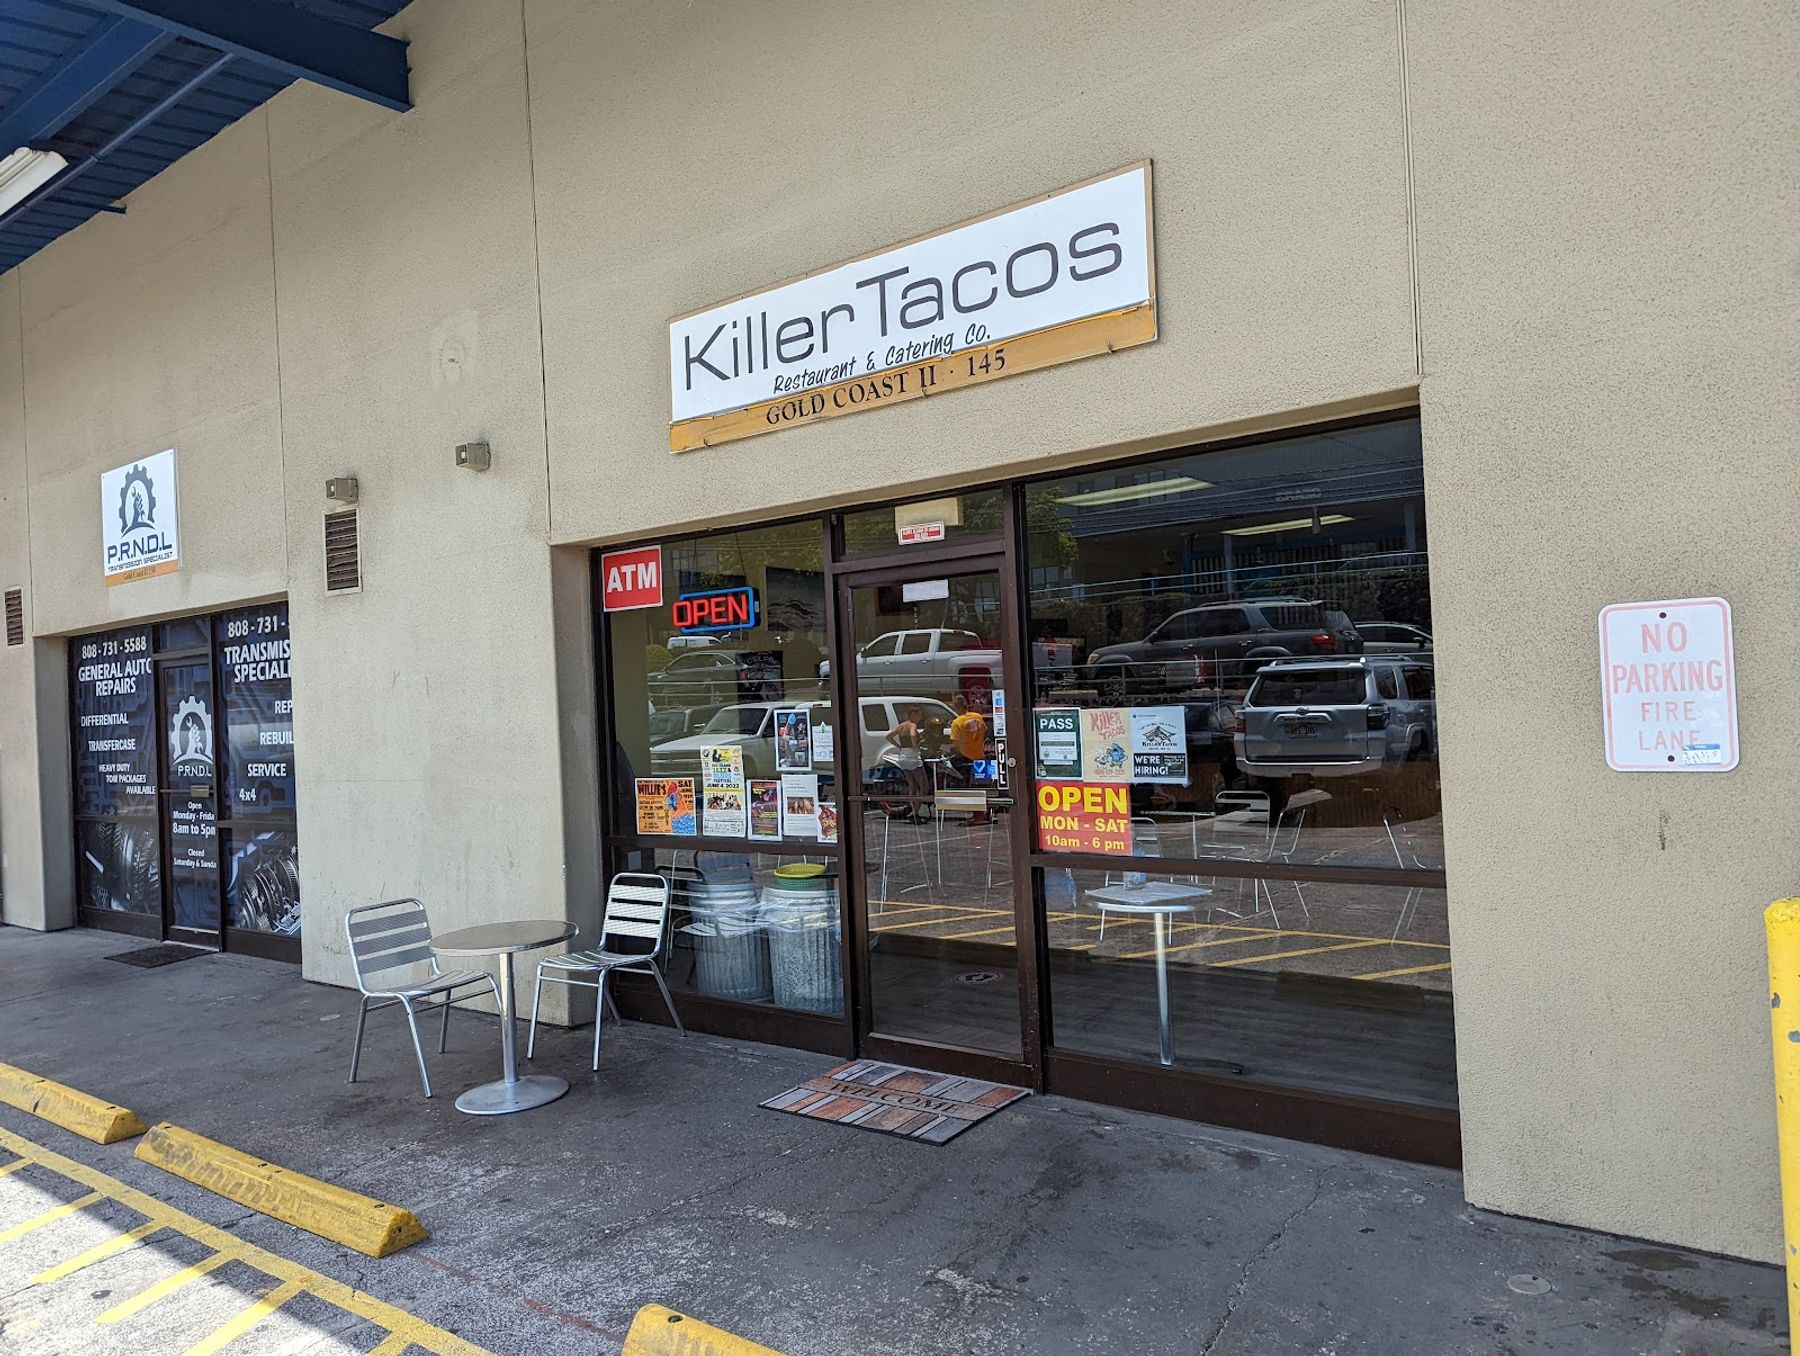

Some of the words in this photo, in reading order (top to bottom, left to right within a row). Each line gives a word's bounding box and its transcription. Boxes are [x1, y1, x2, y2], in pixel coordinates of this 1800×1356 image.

[773, 356, 856, 394] Restaurant
[866, 351, 876, 371] &
[885, 332, 954, 366] Catering
[766, 393, 825, 425] GOLD
[833, 371, 909, 409] COAST
[918, 365, 937, 388] II
[967, 350, 1005, 377] 145
[107, 532, 173, 565] P.R.N.D.L
[607, 561, 657, 593] ATM
[672, 595, 748, 627] OPEN
[1641, 621, 1688, 654] NO
[78, 661, 123, 682] GENERAL
[1612, 659, 1723, 694] PARKING
[95, 677, 137, 697] REPAIRS
[1641, 700, 1697, 722] FIRE
[81, 712, 129, 727] DIFFERENTIAL
[1040, 718, 1073, 730] PASS
[88, 738, 136, 752] TRANSFERCASE
[99, 764, 115, 772] HEAVY
[117, 763, 130, 772] DUTY
[247, 763, 287, 777] SERVICE
[997, 743, 1006, 785] PULL
[1135, 766, 1168, 776] HIRING!
[119, 774, 147, 783] PACKAGES
[126, 785, 157, 795] AVAILABLE
[239, 788, 257, 801] 4x4
[187, 801, 203, 811] Open
[1038, 785, 1128, 814] OPEN
[173, 810, 195, 822] Monday
[1040, 815, 1079, 831] MON
[1095, 818, 1128, 833] SAT
[173, 822, 189, 835] 8am
[191, 823, 199, 835] to
[1045, 835, 1080, 847] 10am
[1092, 837, 1101, 849] 6
[1105, 840, 1125, 851] pm
[187, 848, 205, 857] Closed
[173, 857, 195, 868] Saturday
[831, 1082, 960, 1112] WELCOME
